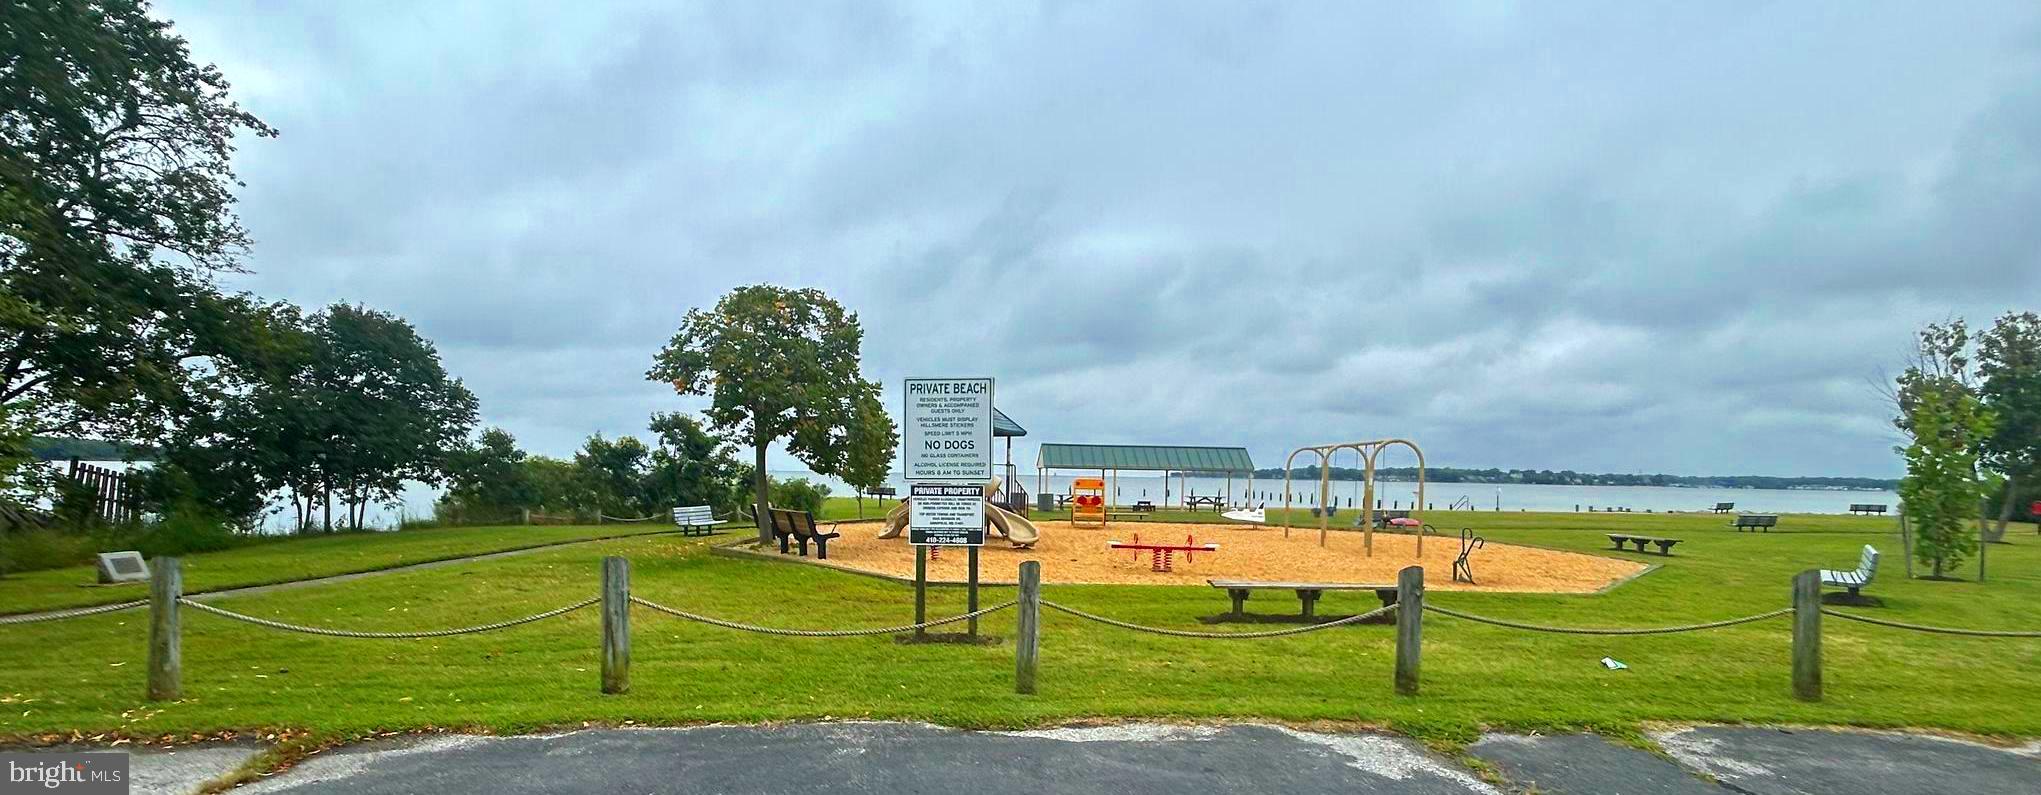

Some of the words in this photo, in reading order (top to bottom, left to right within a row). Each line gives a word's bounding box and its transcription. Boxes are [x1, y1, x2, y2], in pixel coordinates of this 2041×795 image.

[910, 384, 950, 394] PRIVATE
[954, 383, 986, 394] BEACH
[925, 441, 940, 449] NO
[945, 440, 974, 449] DOGS
